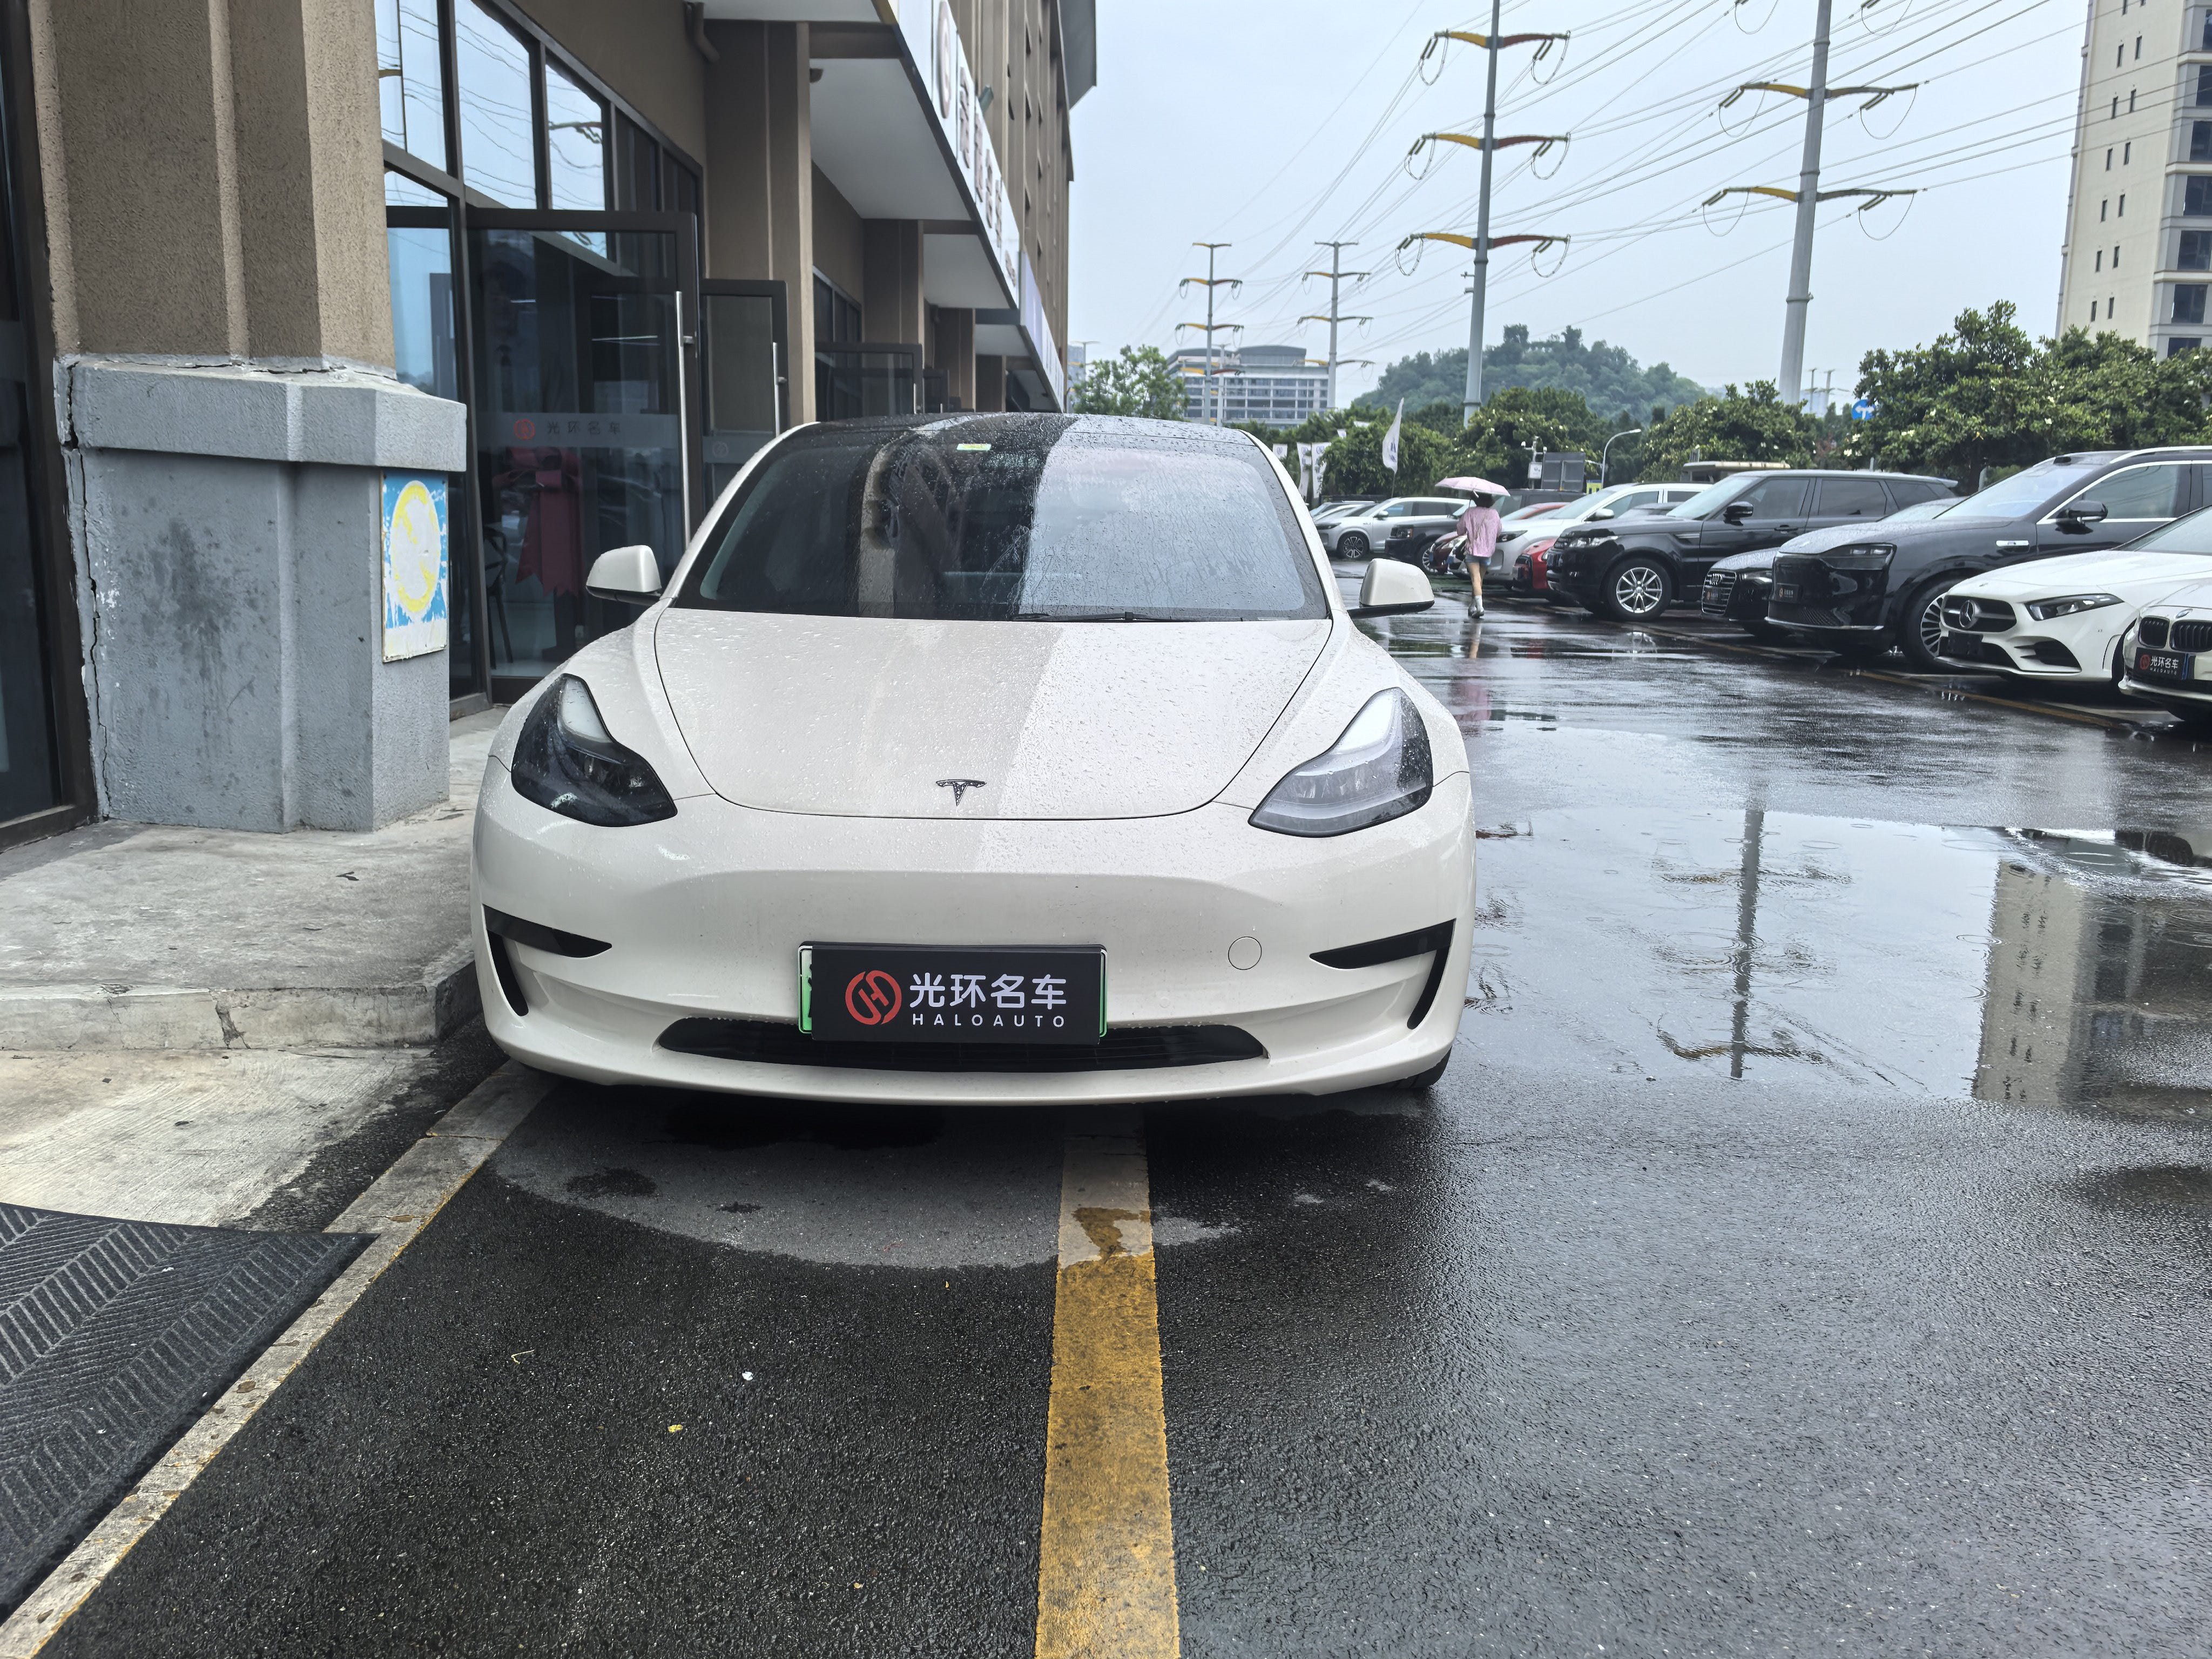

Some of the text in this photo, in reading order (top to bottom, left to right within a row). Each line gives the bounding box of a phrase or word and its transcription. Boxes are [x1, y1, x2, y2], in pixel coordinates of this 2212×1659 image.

[2150, 656, 2179, 669] 光环名车
[910, 973, 1067, 1009] 光环名车
[913, 1013, 1064, 1028] HALOAUTO
